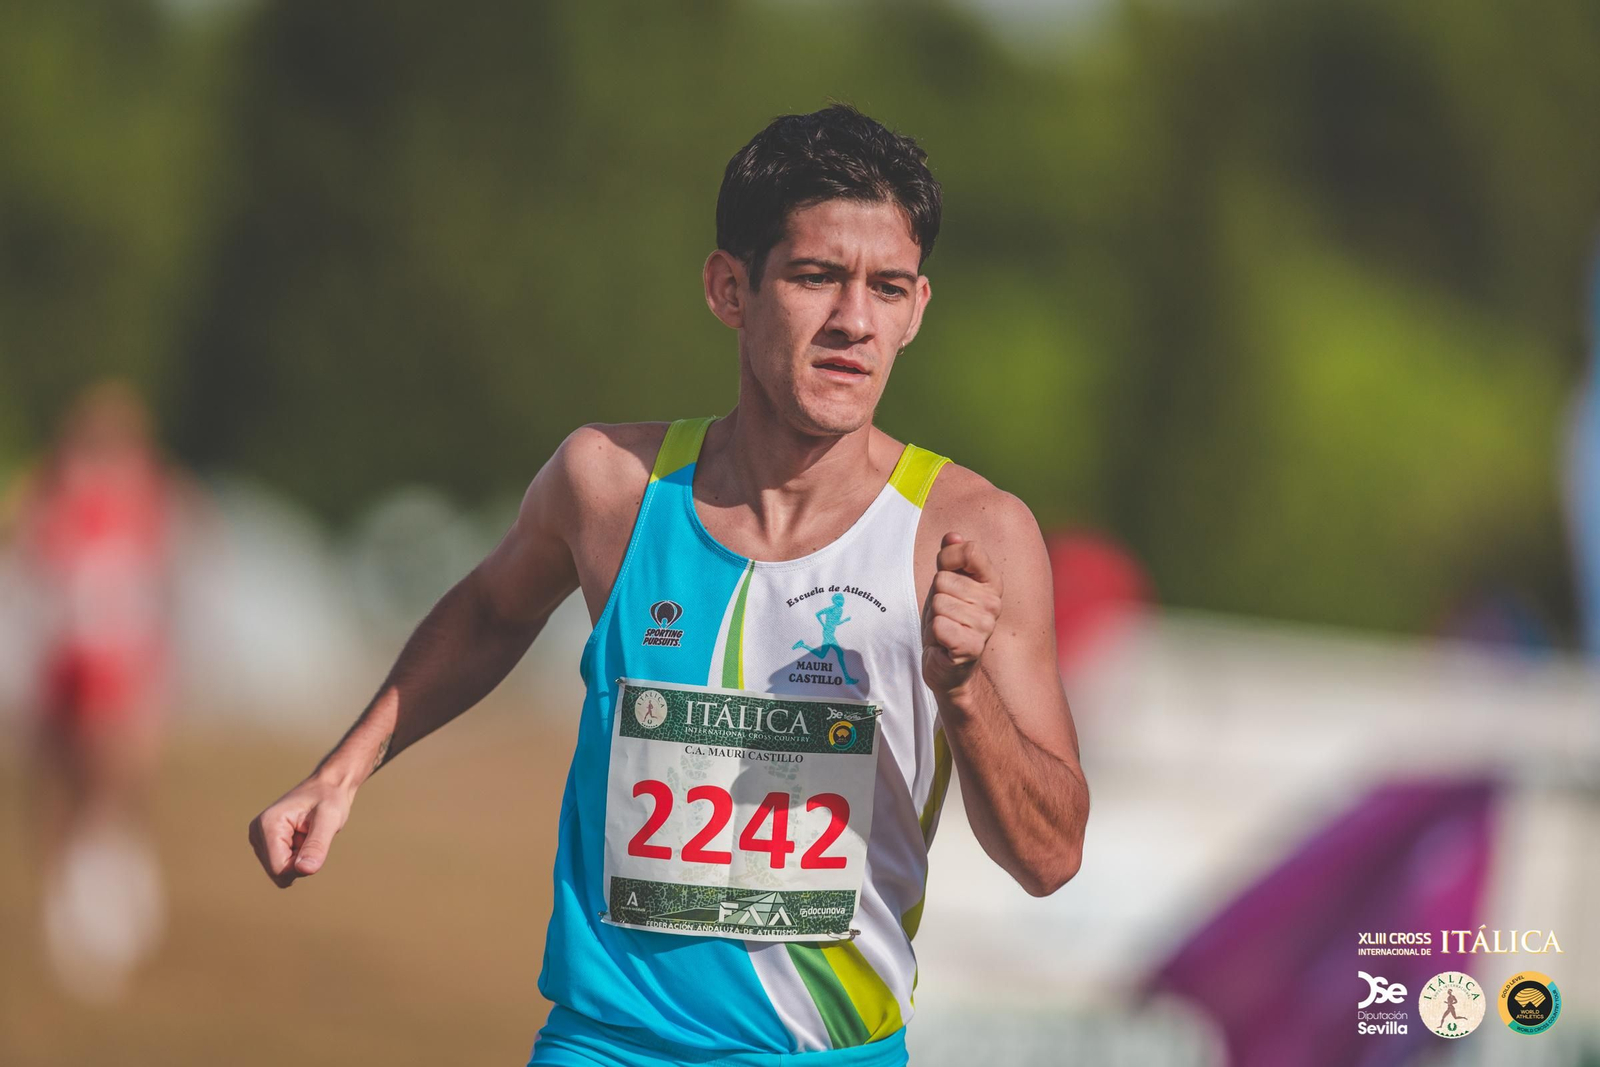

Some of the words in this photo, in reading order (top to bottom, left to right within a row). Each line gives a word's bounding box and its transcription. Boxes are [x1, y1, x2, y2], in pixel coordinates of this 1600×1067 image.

[786, 586, 825, 608] Escuela
[843, 585, 887, 613] Atletismo
[645, 628, 683, 638] SPORTING
[796, 661, 833, 672] MAURI
[788, 673, 843, 686] CASTILLO
[685, 697, 811, 736] ITÁLICA
[685, 726, 746, 738] INTERNATIONAL
[748, 732, 772, 740] CROSS
[685, 745, 705, 756] C.A.
[708, 748, 745, 759] MAURI
[748, 751, 804, 763] CASTILLO
[627, 779, 850, 869] 2242
[808, 906, 846, 915] docunova
[646, 920, 694, 931] FEDERACIÓN
[697, 924, 741, 934] ANDALUZA
